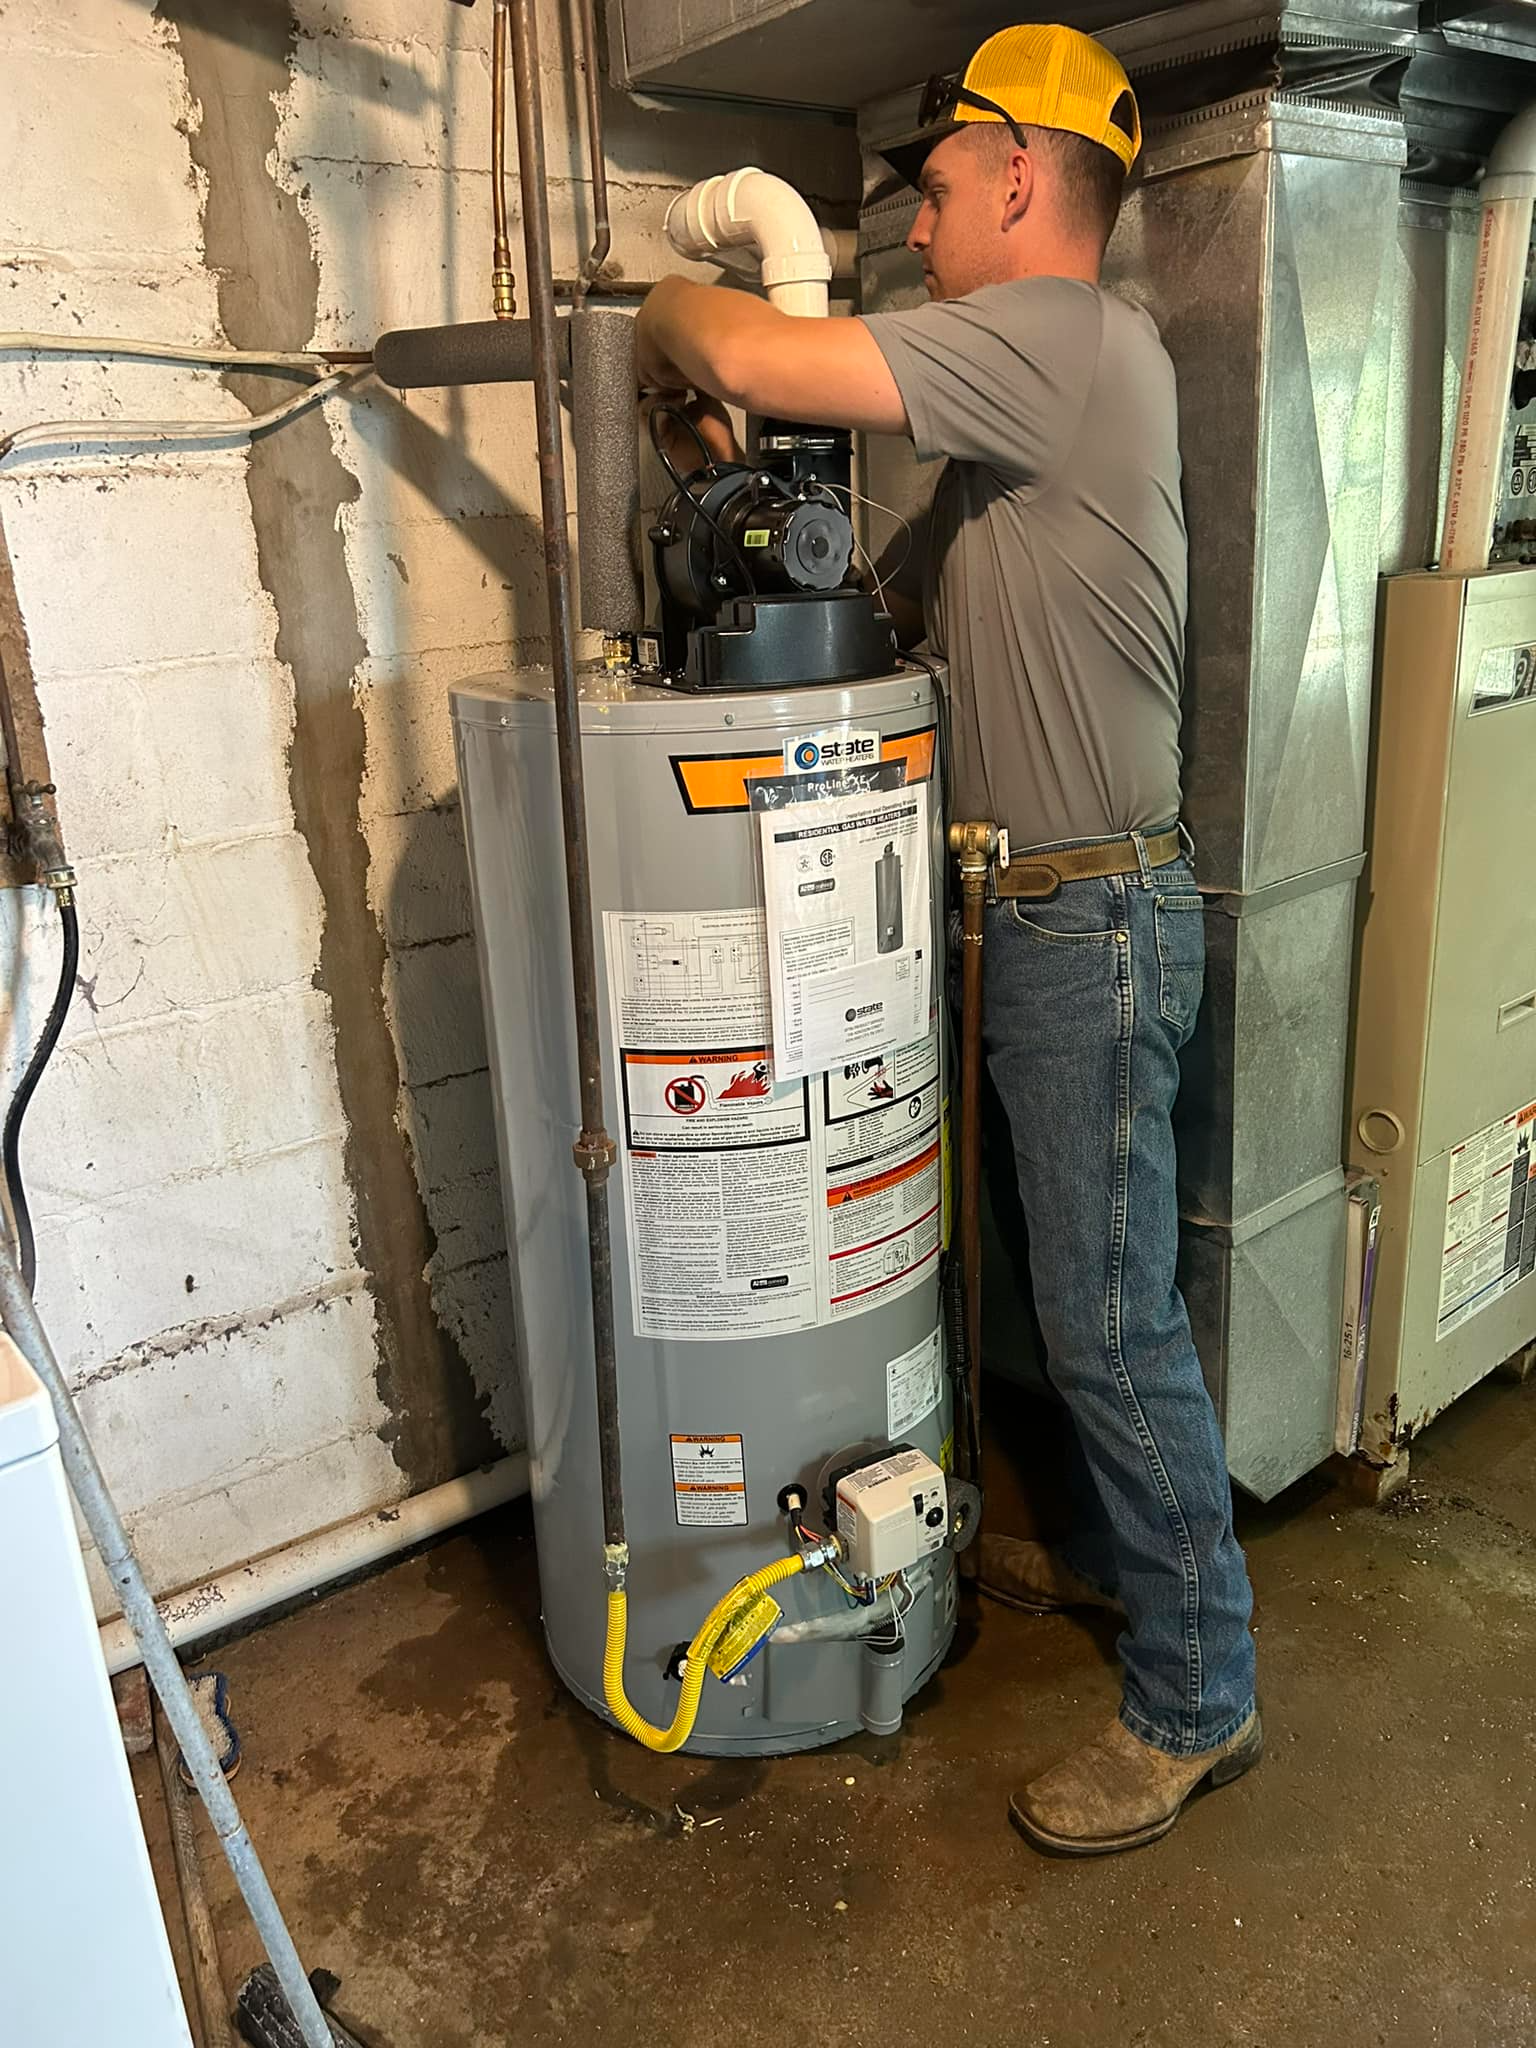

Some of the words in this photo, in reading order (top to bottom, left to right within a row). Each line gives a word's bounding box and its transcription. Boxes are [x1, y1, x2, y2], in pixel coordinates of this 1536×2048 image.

[1473, 306, 1482, 326] ASTM
[1451, 500, 1460, 518] ASTM
[821, 738, 874, 759] state
[807, 778, 849, 792] ProLine
[798, 825, 841, 838] RESIDENTIAL
[841, 821, 856, 831] GAS
[855, 817, 877, 827] WATER
[877, 811, 901, 822] HEATERS
[857, 1002, 883, 1016] state
[698, 1054, 738, 1065] WARNING
